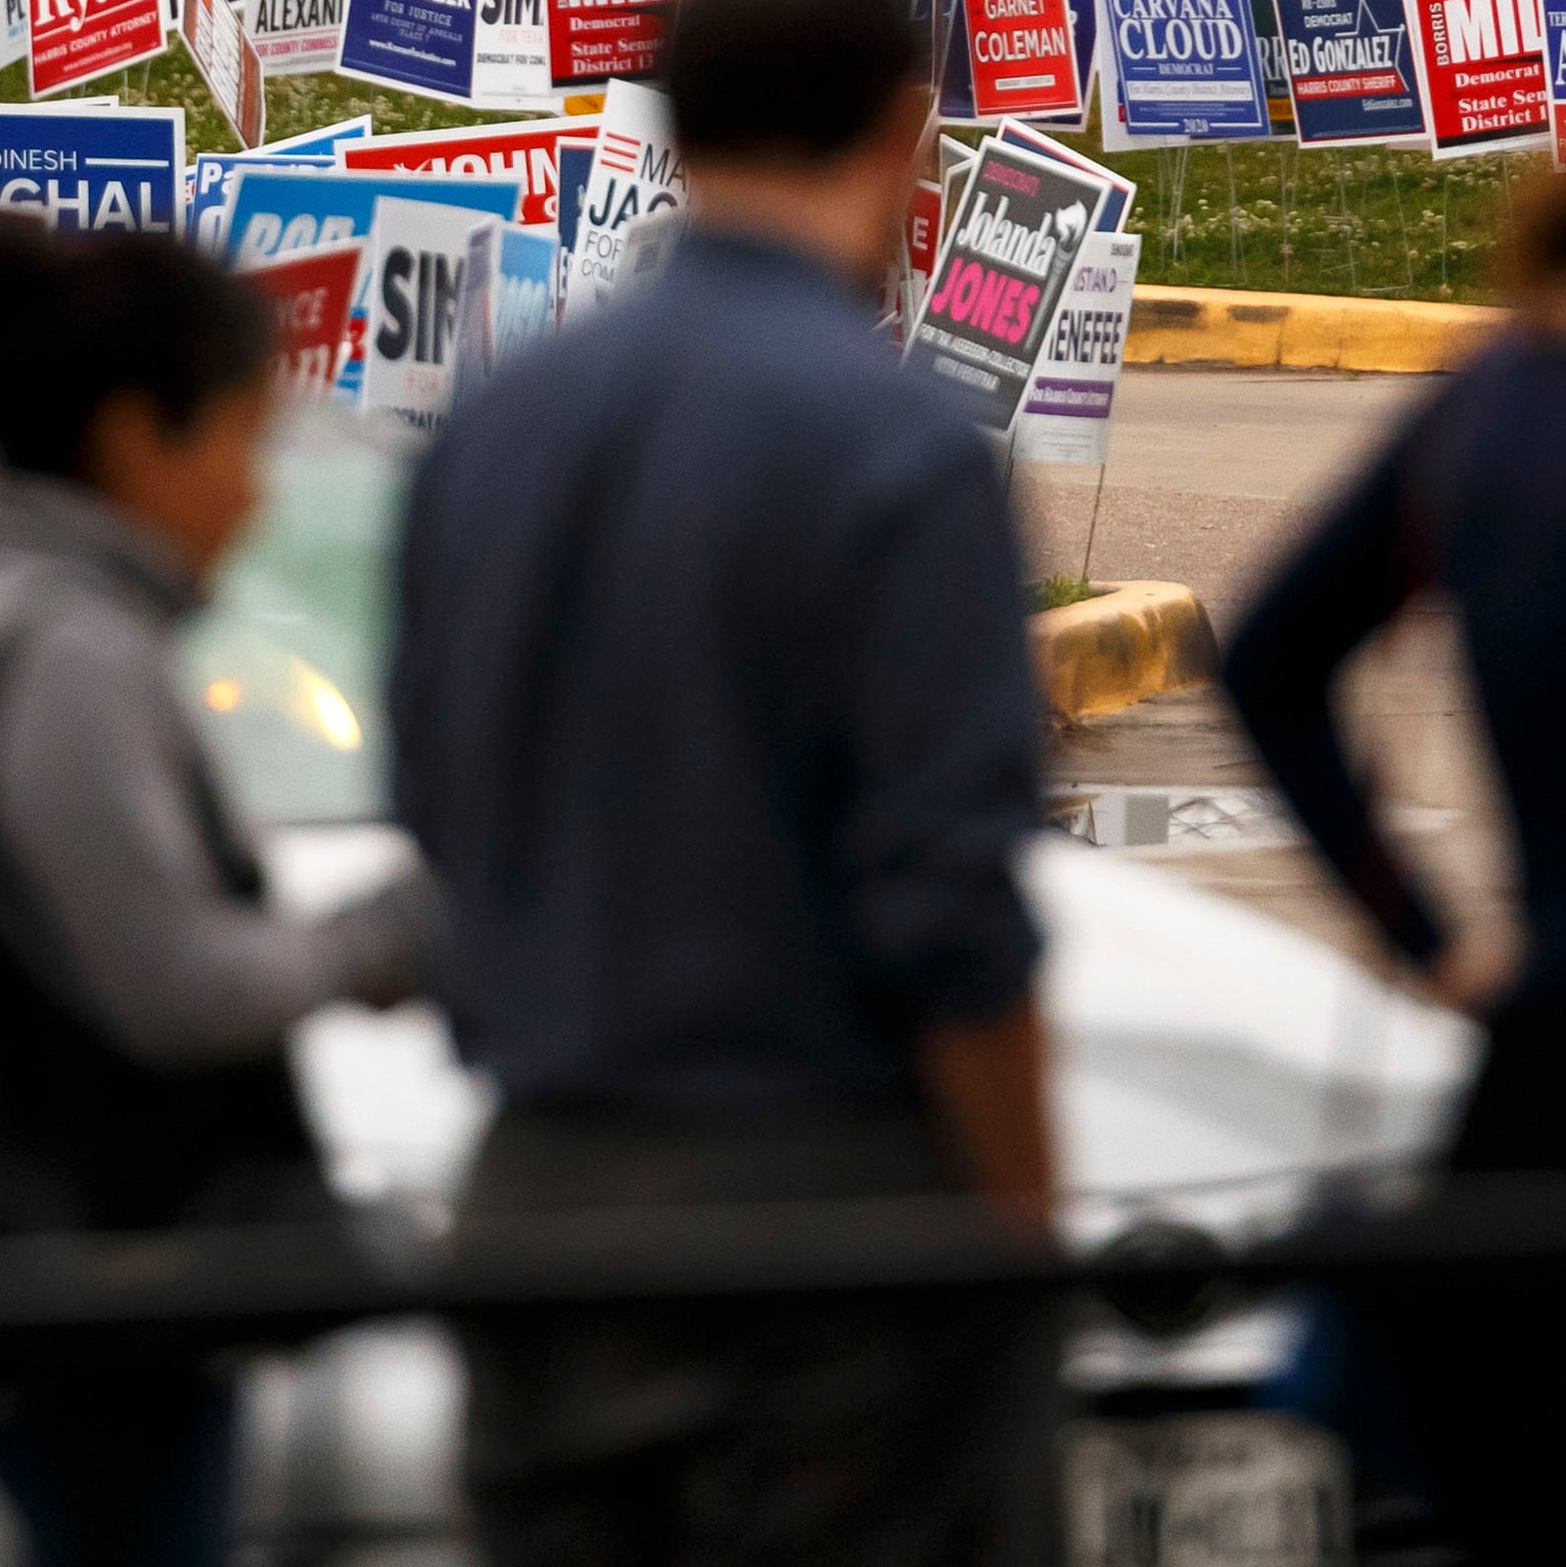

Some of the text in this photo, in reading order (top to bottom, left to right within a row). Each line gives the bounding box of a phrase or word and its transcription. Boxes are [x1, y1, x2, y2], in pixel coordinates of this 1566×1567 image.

[384, 0, 453, 27] FOR JUSTICE
[569, 15, 641, 31] Democrat
[1304, 11, 1354, 29] DEMOCRAT
[34, 43, 68, 65] HARRIS
[69, 31, 108, 52] COUNTY
[110, 11, 159, 37] ATTORNEY
[974, 27, 1067, 63] COLEMAN
[1119, 17, 1244, 61] CLOUD
[1429, 1, 1450, 67] BORRIS
[571, 41, 614, 56] State
[1312, 34, 1393, 73] GONZALEZ
[571, 57, 632, 75] District
[1454, 64, 1540, 88] Democrat
[1297, 74, 1397, 95] HARRIS COUNTY SHERIFF
[1458, 94, 1508, 115] State
[1461, 109, 1532, 133] District
[957, 190, 1057, 277] Jolanda
[930, 256, 1042, 344] JONES
